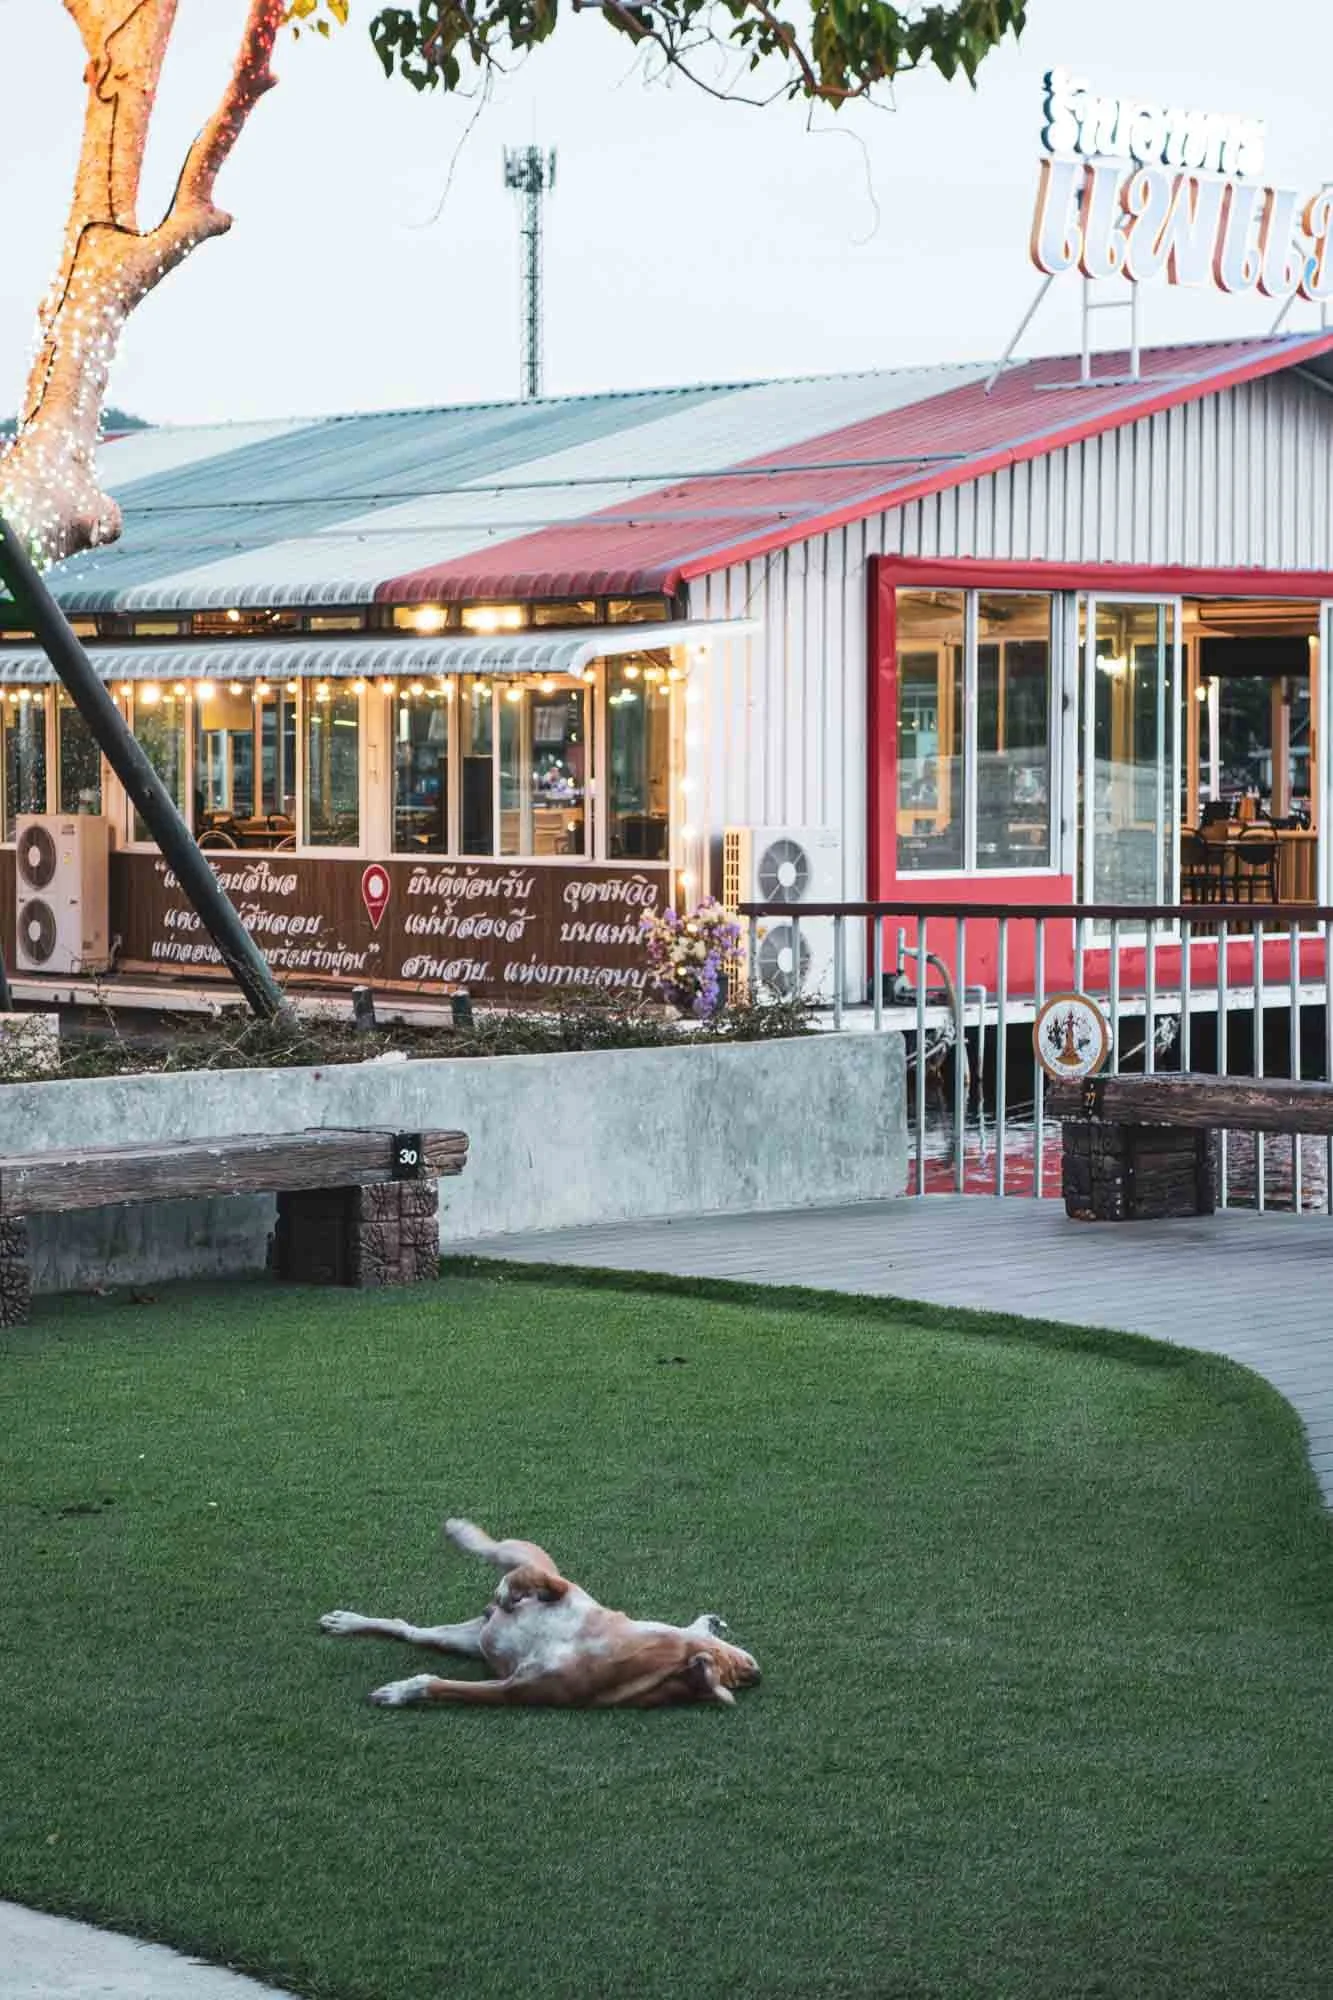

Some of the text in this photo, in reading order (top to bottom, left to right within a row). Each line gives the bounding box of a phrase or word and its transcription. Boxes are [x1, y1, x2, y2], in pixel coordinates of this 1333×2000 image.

[407, 865, 536, 900] ยินดีต้อนรับ
[562, 874, 659, 912] จุดชมวิว
[404, 898, 537, 943] แม่น้ำสองสี
[399, 1148, 418, 1166] 30
